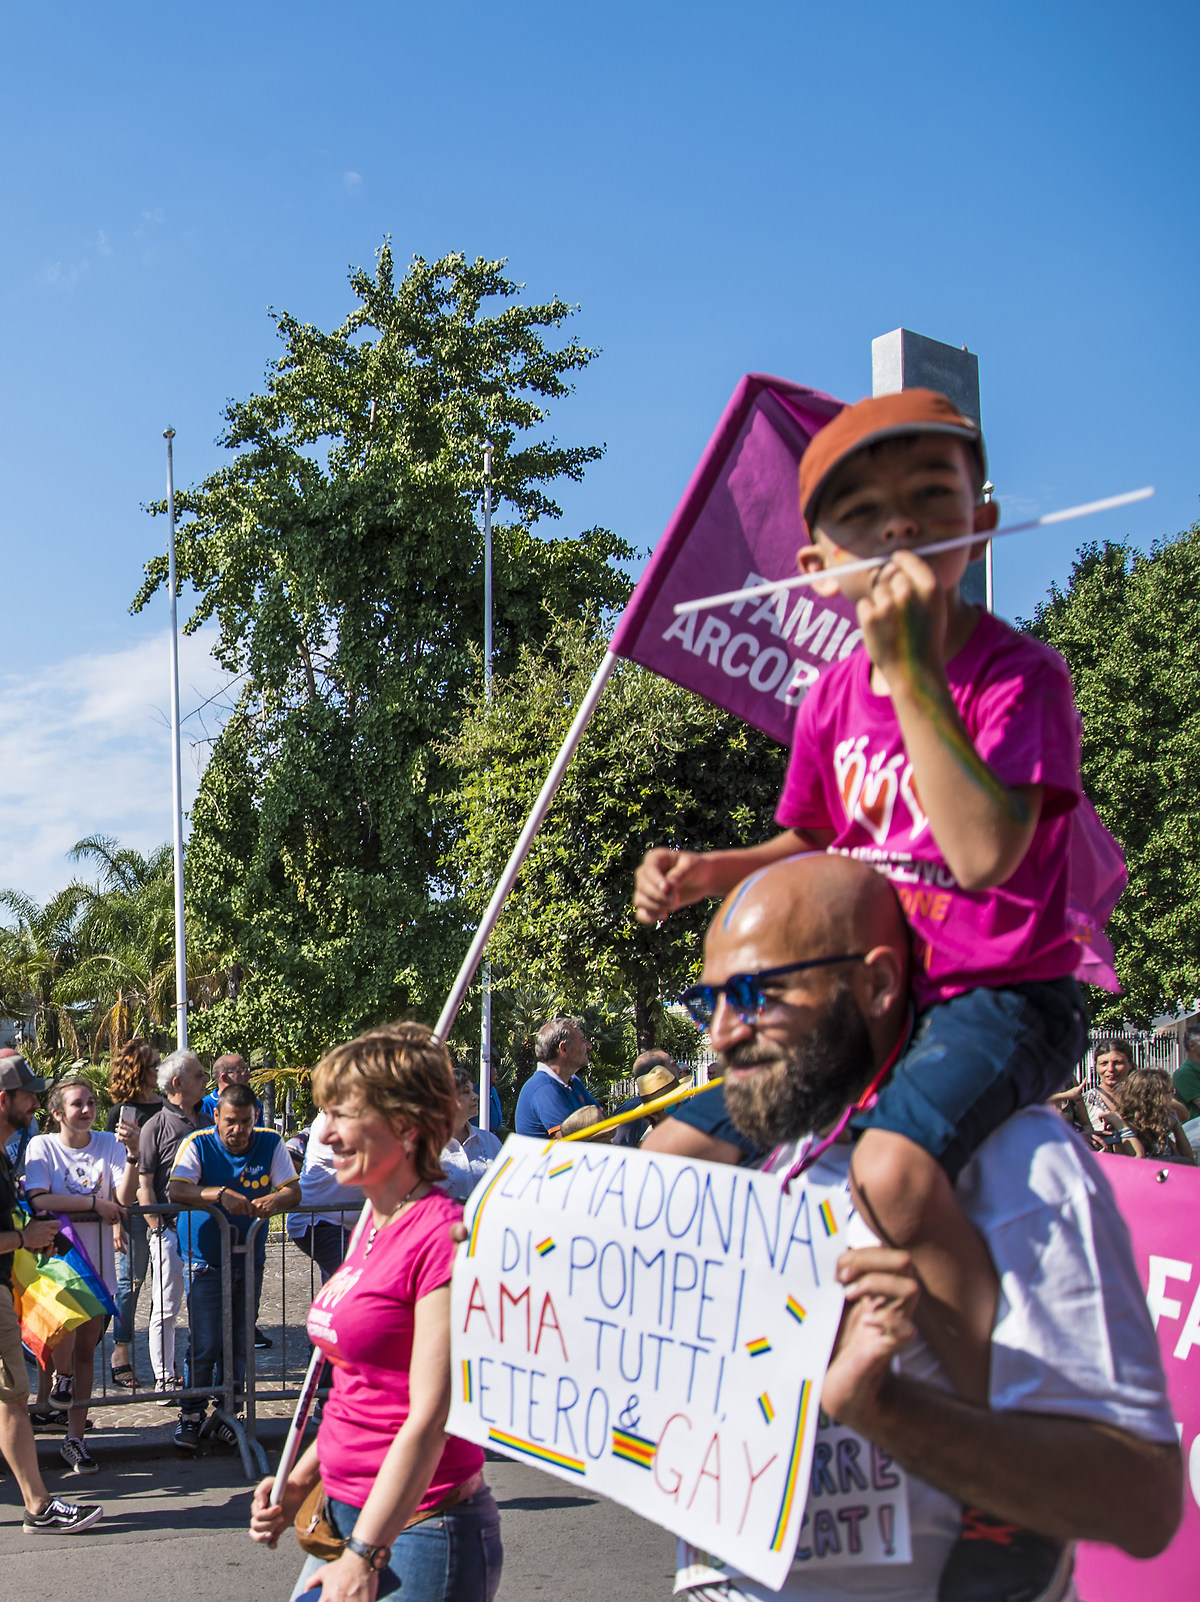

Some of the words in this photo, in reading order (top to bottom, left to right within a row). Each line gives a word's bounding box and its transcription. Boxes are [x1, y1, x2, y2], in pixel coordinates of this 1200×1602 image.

[500, 1153, 552, 1203] LA
[562, 1153, 820, 1287] MADONNA
[463, 1277, 569, 1363] AMA
[502, 1226, 532, 1277] DI
[568, 1235, 746, 1353] POMPEI
[479, 1356, 610, 1460] ETERO
[618, 1394, 642, 1431] &
[653, 1412, 778, 1536] GAY
[812, 1437, 900, 1497] RRE
